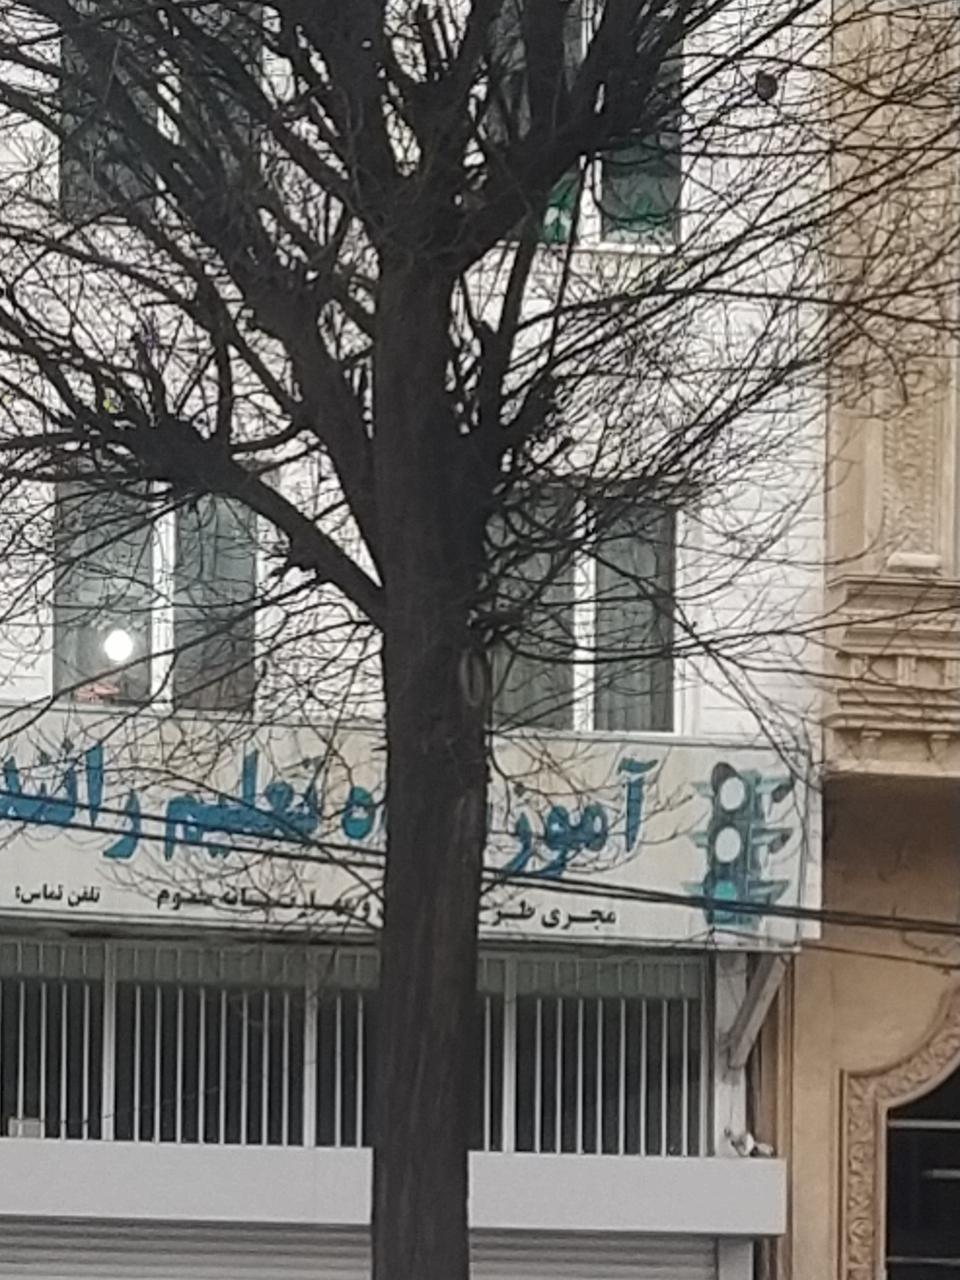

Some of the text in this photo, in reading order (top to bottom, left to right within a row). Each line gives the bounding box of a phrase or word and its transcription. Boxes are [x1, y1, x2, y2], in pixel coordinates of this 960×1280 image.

[164, 748, 321, 862] تعلیم
[342, 756, 659, 877] آموزه
[14, 882, 65, 904] تماس:
[67, 885, 101, 907] تلفن
[481, 899, 617, 931] مجری طر
